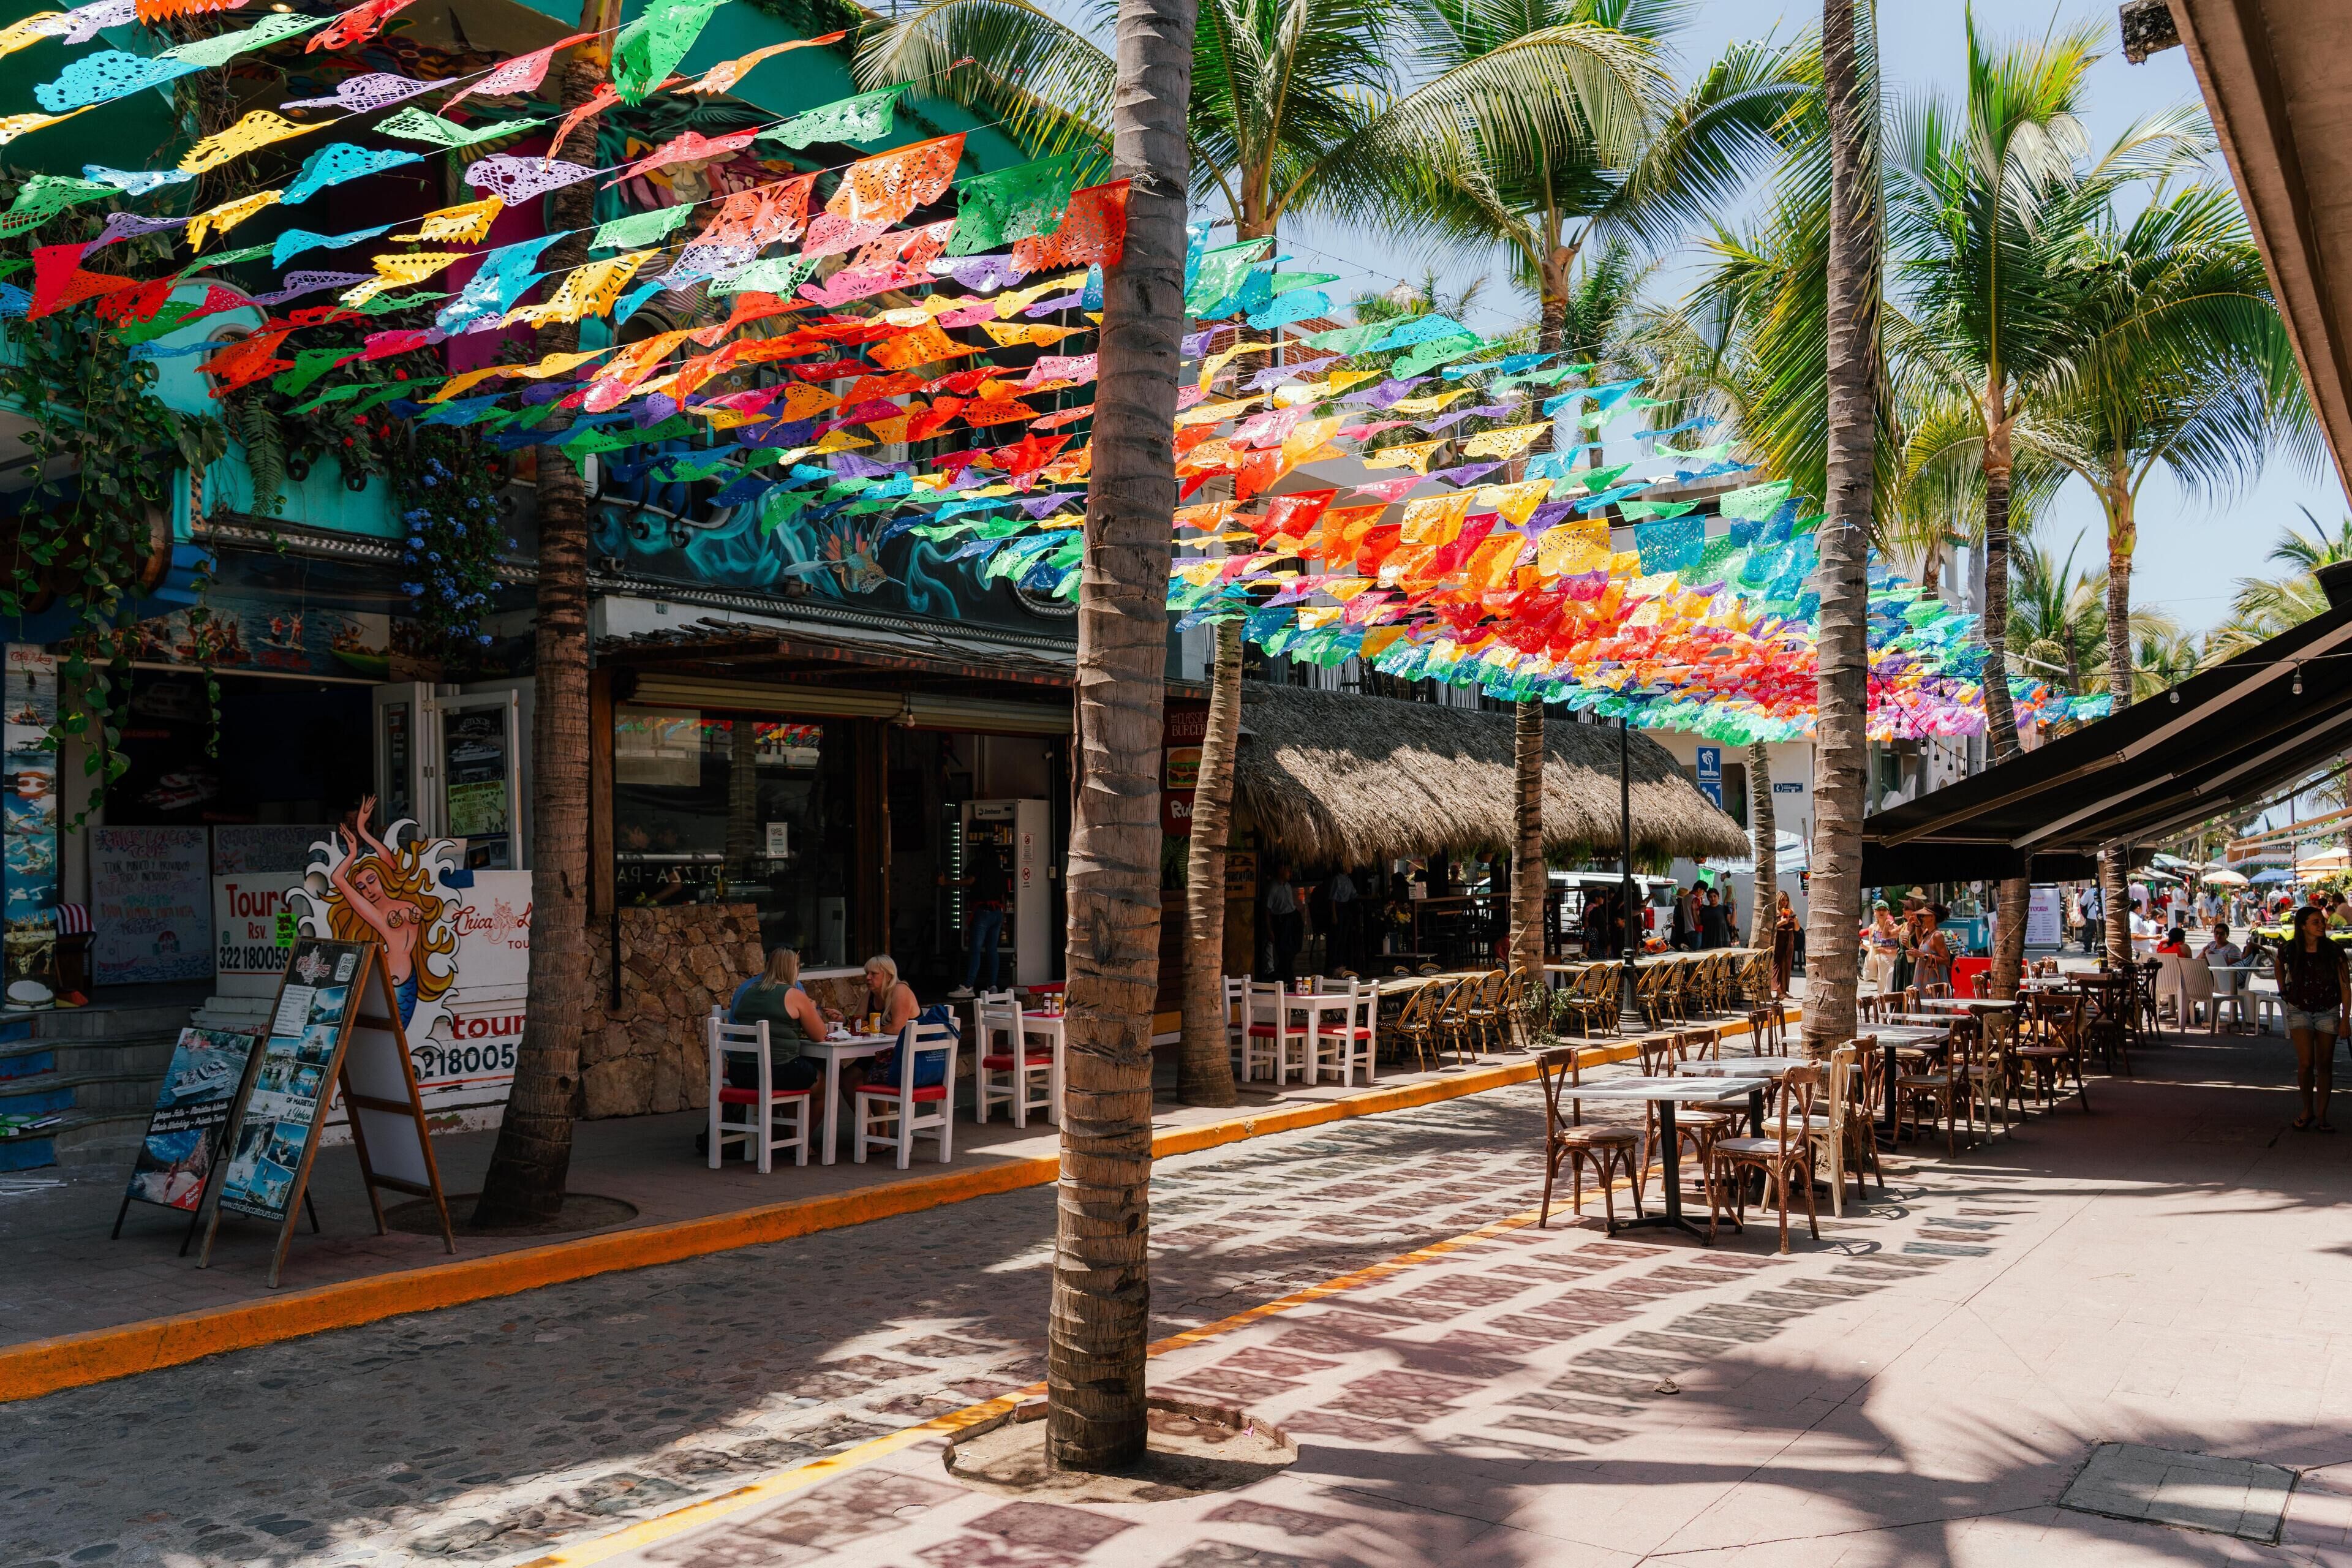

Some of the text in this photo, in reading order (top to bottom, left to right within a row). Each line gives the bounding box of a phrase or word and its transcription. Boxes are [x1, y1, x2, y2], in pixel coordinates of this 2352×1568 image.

[1177, 711, 1207, 725] CLASSIC
[1172, 724, 1206, 737] BURGER
[225, 884, 292, 918] Tours
[452, 906, 493, 936] Chica
[248, 922, 267, 939] Rsv.
[508, 940, 529, 949] TOU
[243, 946, 290, 969] 180059
[447, 1014, 526, 1041] tour
[294, 1098, 315, 1107] MARIETAS
[186, 1185, 200, 1200] Book
[186, 1193, 198, 1207] Here
[220, 1199, 284, 1221] www.chicaloccatours.com
